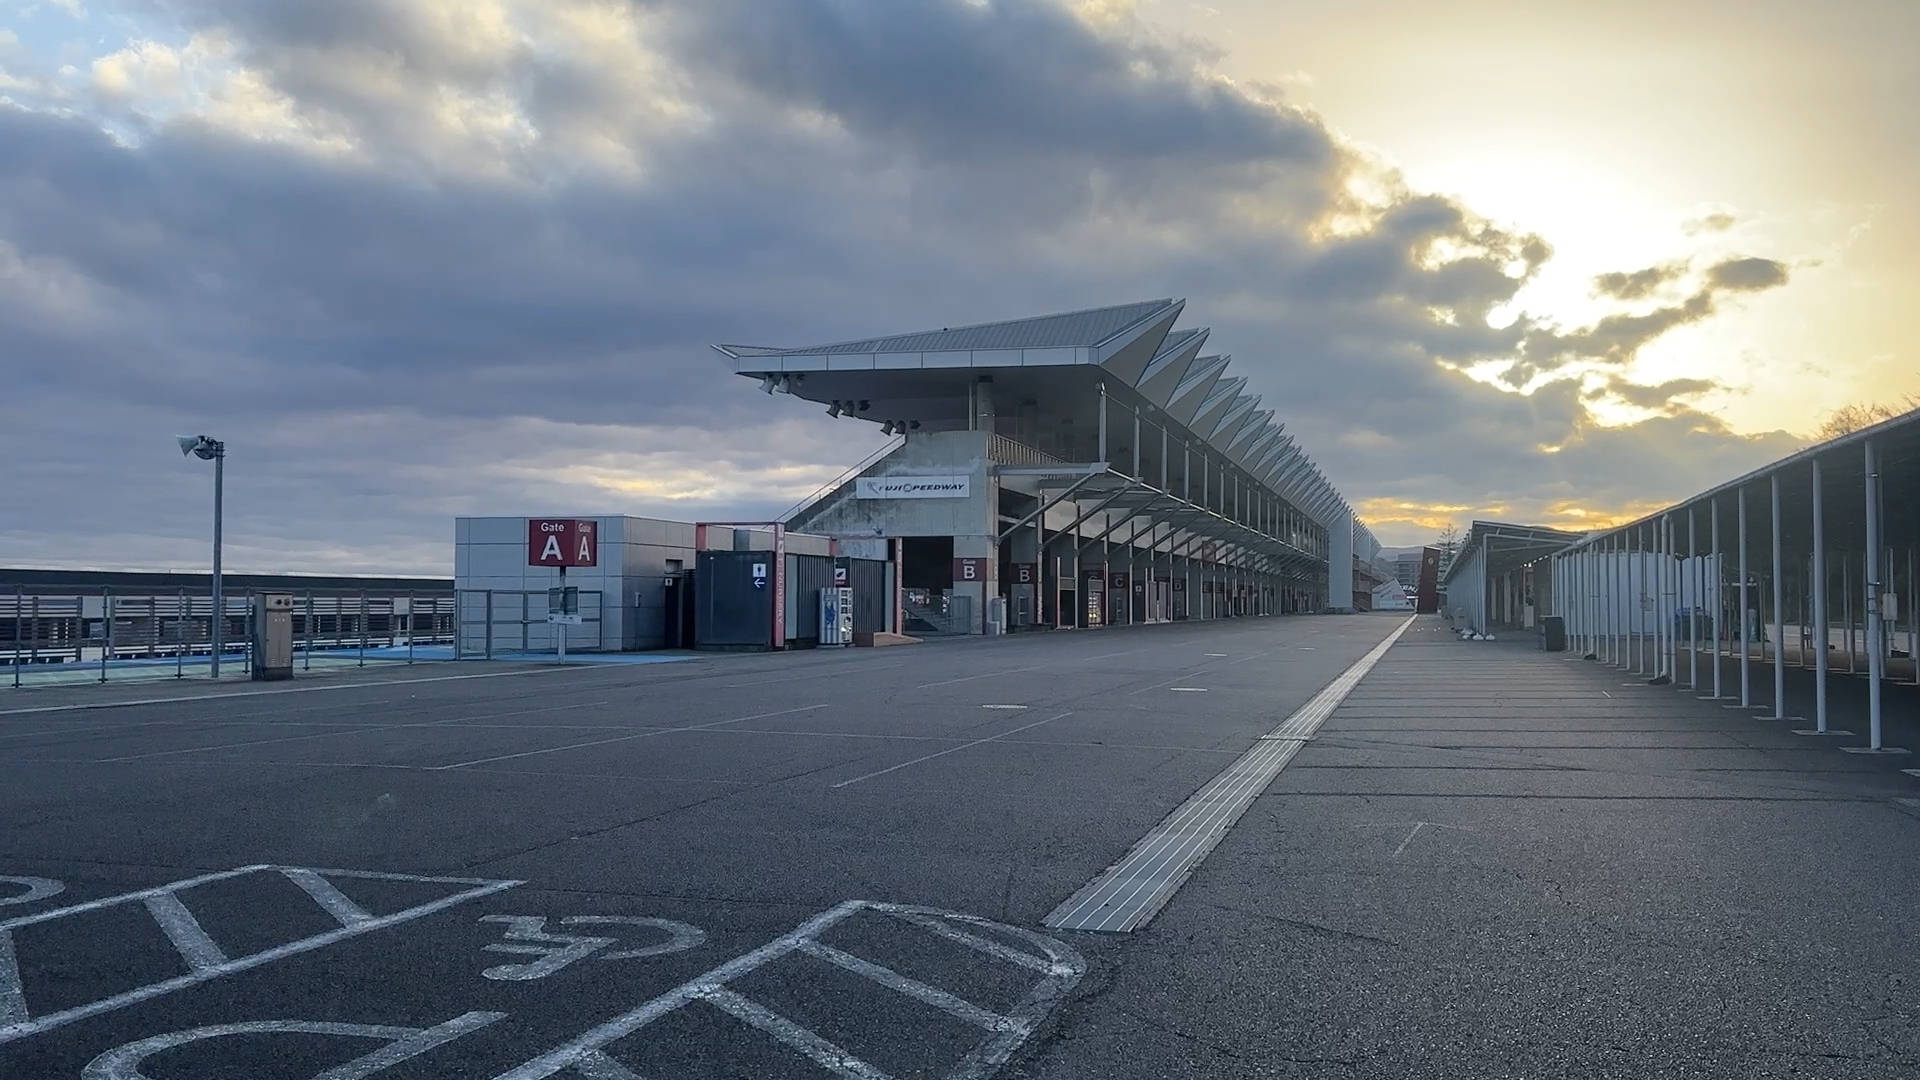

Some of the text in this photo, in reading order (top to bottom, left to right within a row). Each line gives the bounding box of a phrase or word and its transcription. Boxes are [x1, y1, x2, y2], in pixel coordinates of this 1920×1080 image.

[540, 522, 565, 532] Gate
[540, 535, 563, 561] A
[578, 535, 590, 561] A
[964, 565, 976, 579] B
[1019, 569, 1031, 582] B
[1115, 577, 1124, 587] C
